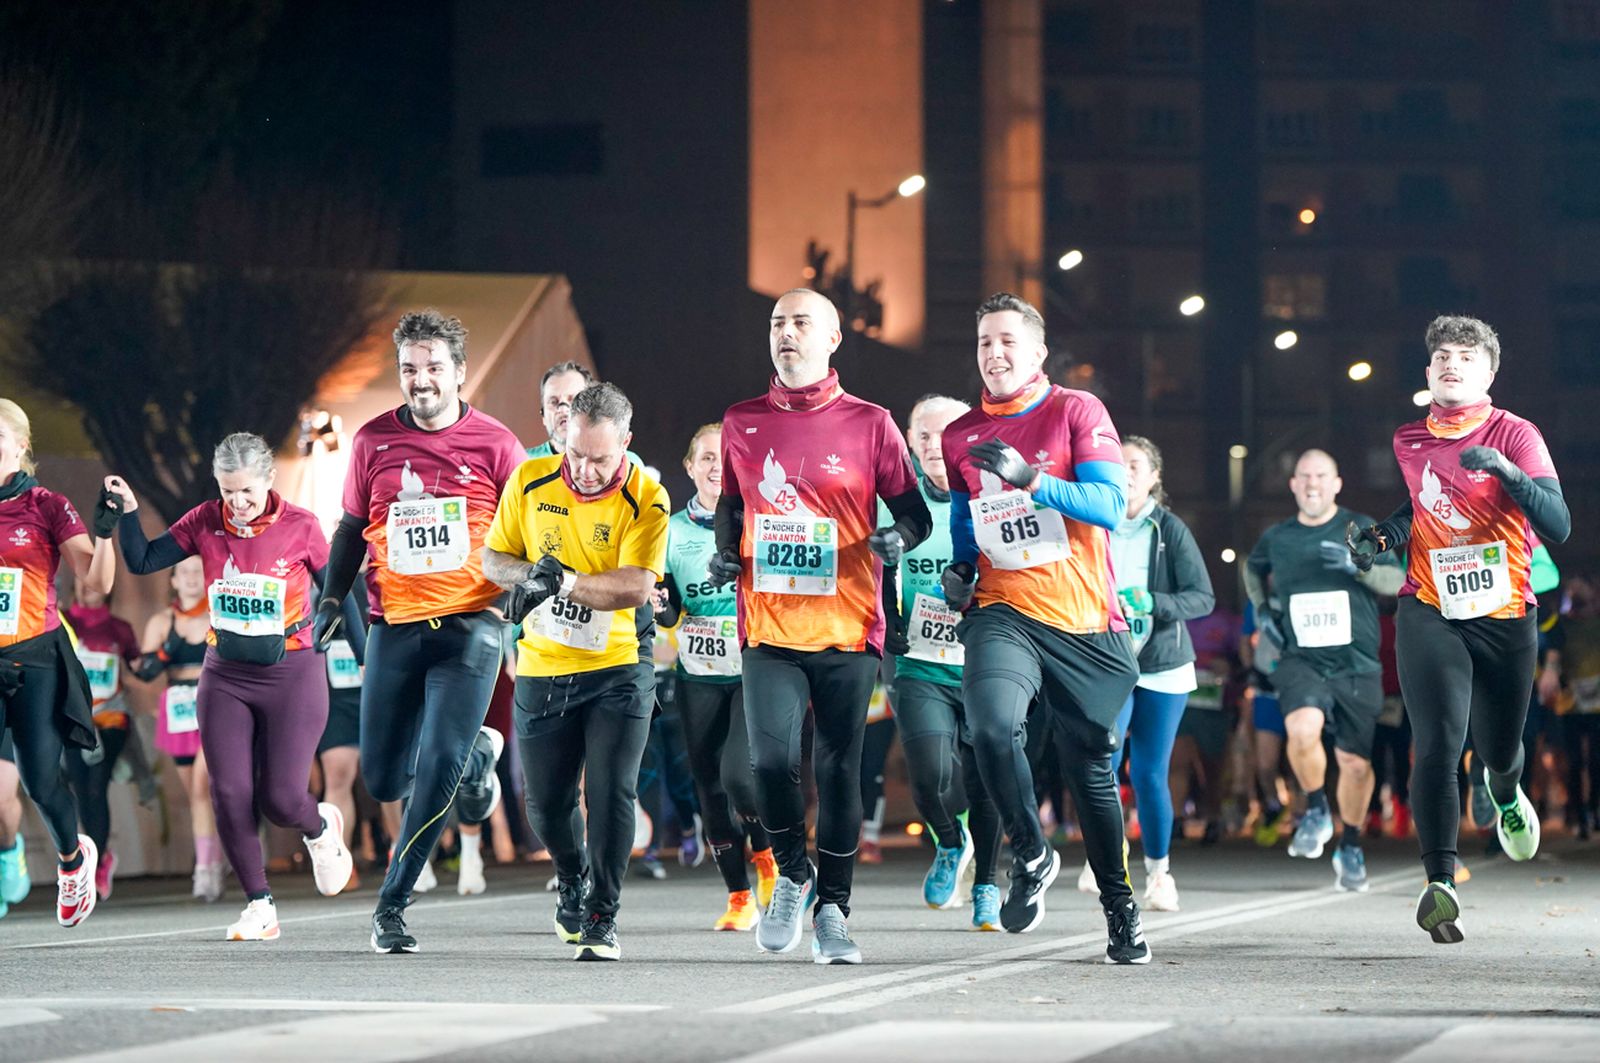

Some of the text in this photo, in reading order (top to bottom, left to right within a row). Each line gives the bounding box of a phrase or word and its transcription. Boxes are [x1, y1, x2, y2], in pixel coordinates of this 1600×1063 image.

[775, 490, 797, 511] 43
[991, 496, 1025, 511] NOCHE DE
[402, 507, 426, 516] NOCHE
[1433, 500, 1452, 519] 43
[394, 519, 409, 527] SAN
[983, 514, 1000, 524] SAN
[771, 524, 806, 533] NOCHE DE
[1000, 515, 1040, 544] 815
[405, 525, 450, 549] 1314
[762, 533, 778, 541] SAN
[767, 543, 822, 568] 8283
[1445, 554, 1466, 563] NOCHE
[907, 558, 953, 574] ser
[1439, 565, 1452, 573] SAN
[1446, 568, 1494, 595] 6109
[218, 594, 275, 615] 13688
[928, 604, 947, 613] NOCHE
[919, 610, 932, 618] SAN
[1303, 612, 1338, 628] 3078
[709, 621, 717, 629] DE
[921, 620, 961, 643] 623
[687, 635, 726, 657] 7283
